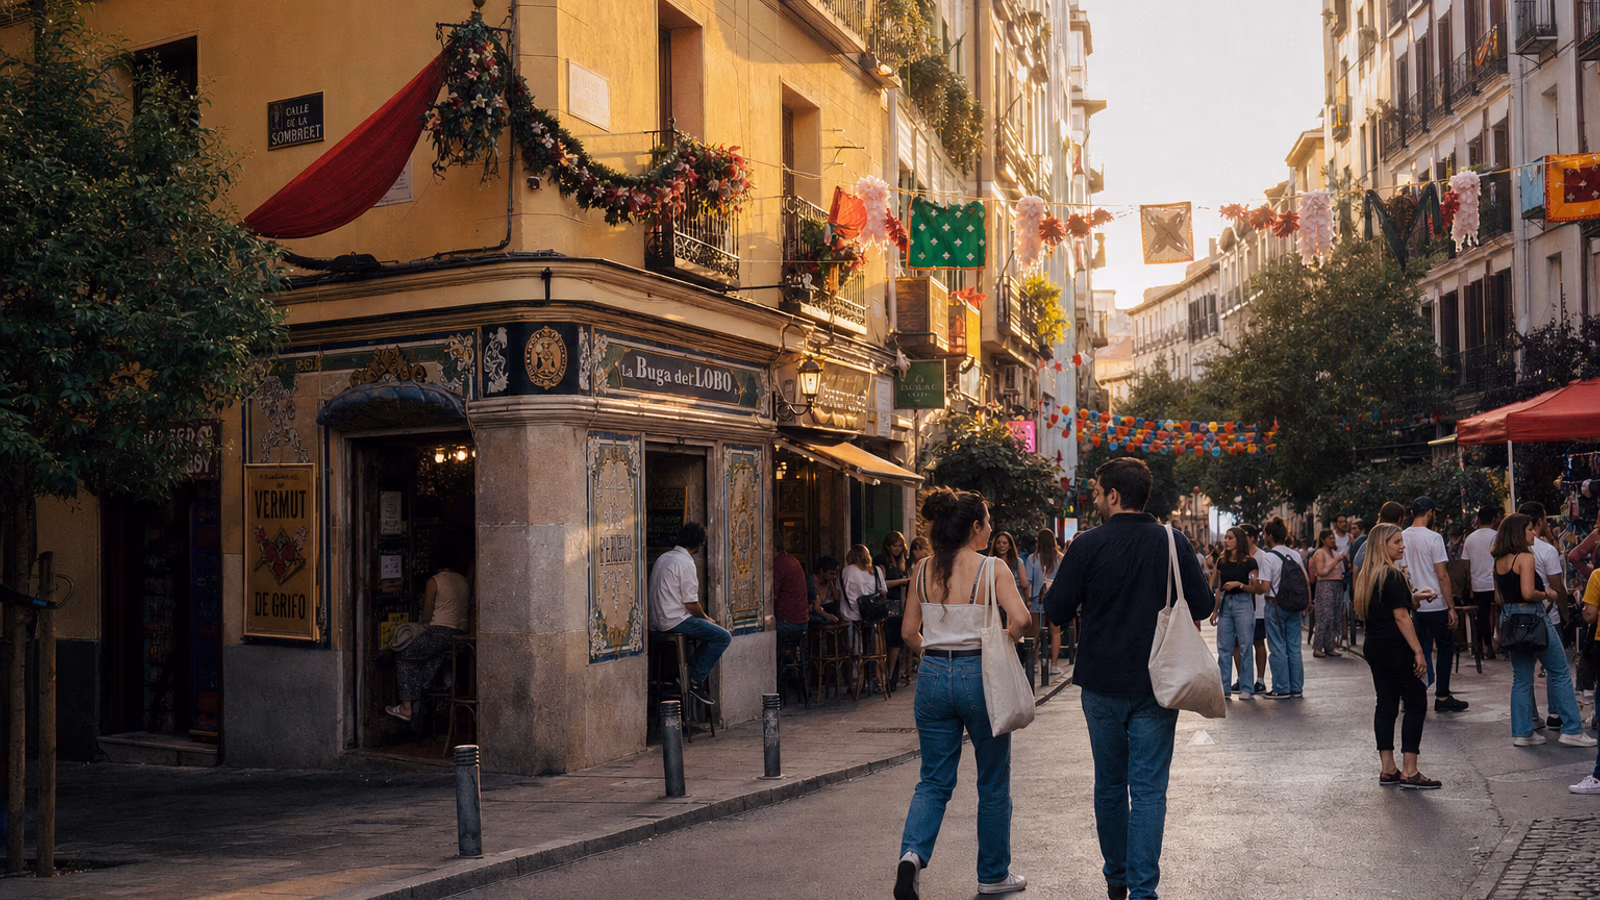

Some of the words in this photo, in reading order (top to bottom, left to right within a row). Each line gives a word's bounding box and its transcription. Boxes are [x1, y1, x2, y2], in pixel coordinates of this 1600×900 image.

[286, 104, 309, 116] CALLE
[287, 118, 295, 127] DE
[298, 117, 307, 126] LA
[621, 365, 633, 378] La
[636, 356, 671, 386] Buga
[694, 366, 732, 392] LOBO
[254, 489, 306, 520] VERMUT
[255, 592, 269, 617] DE
[271, 592, 306, 620] GRIFO
